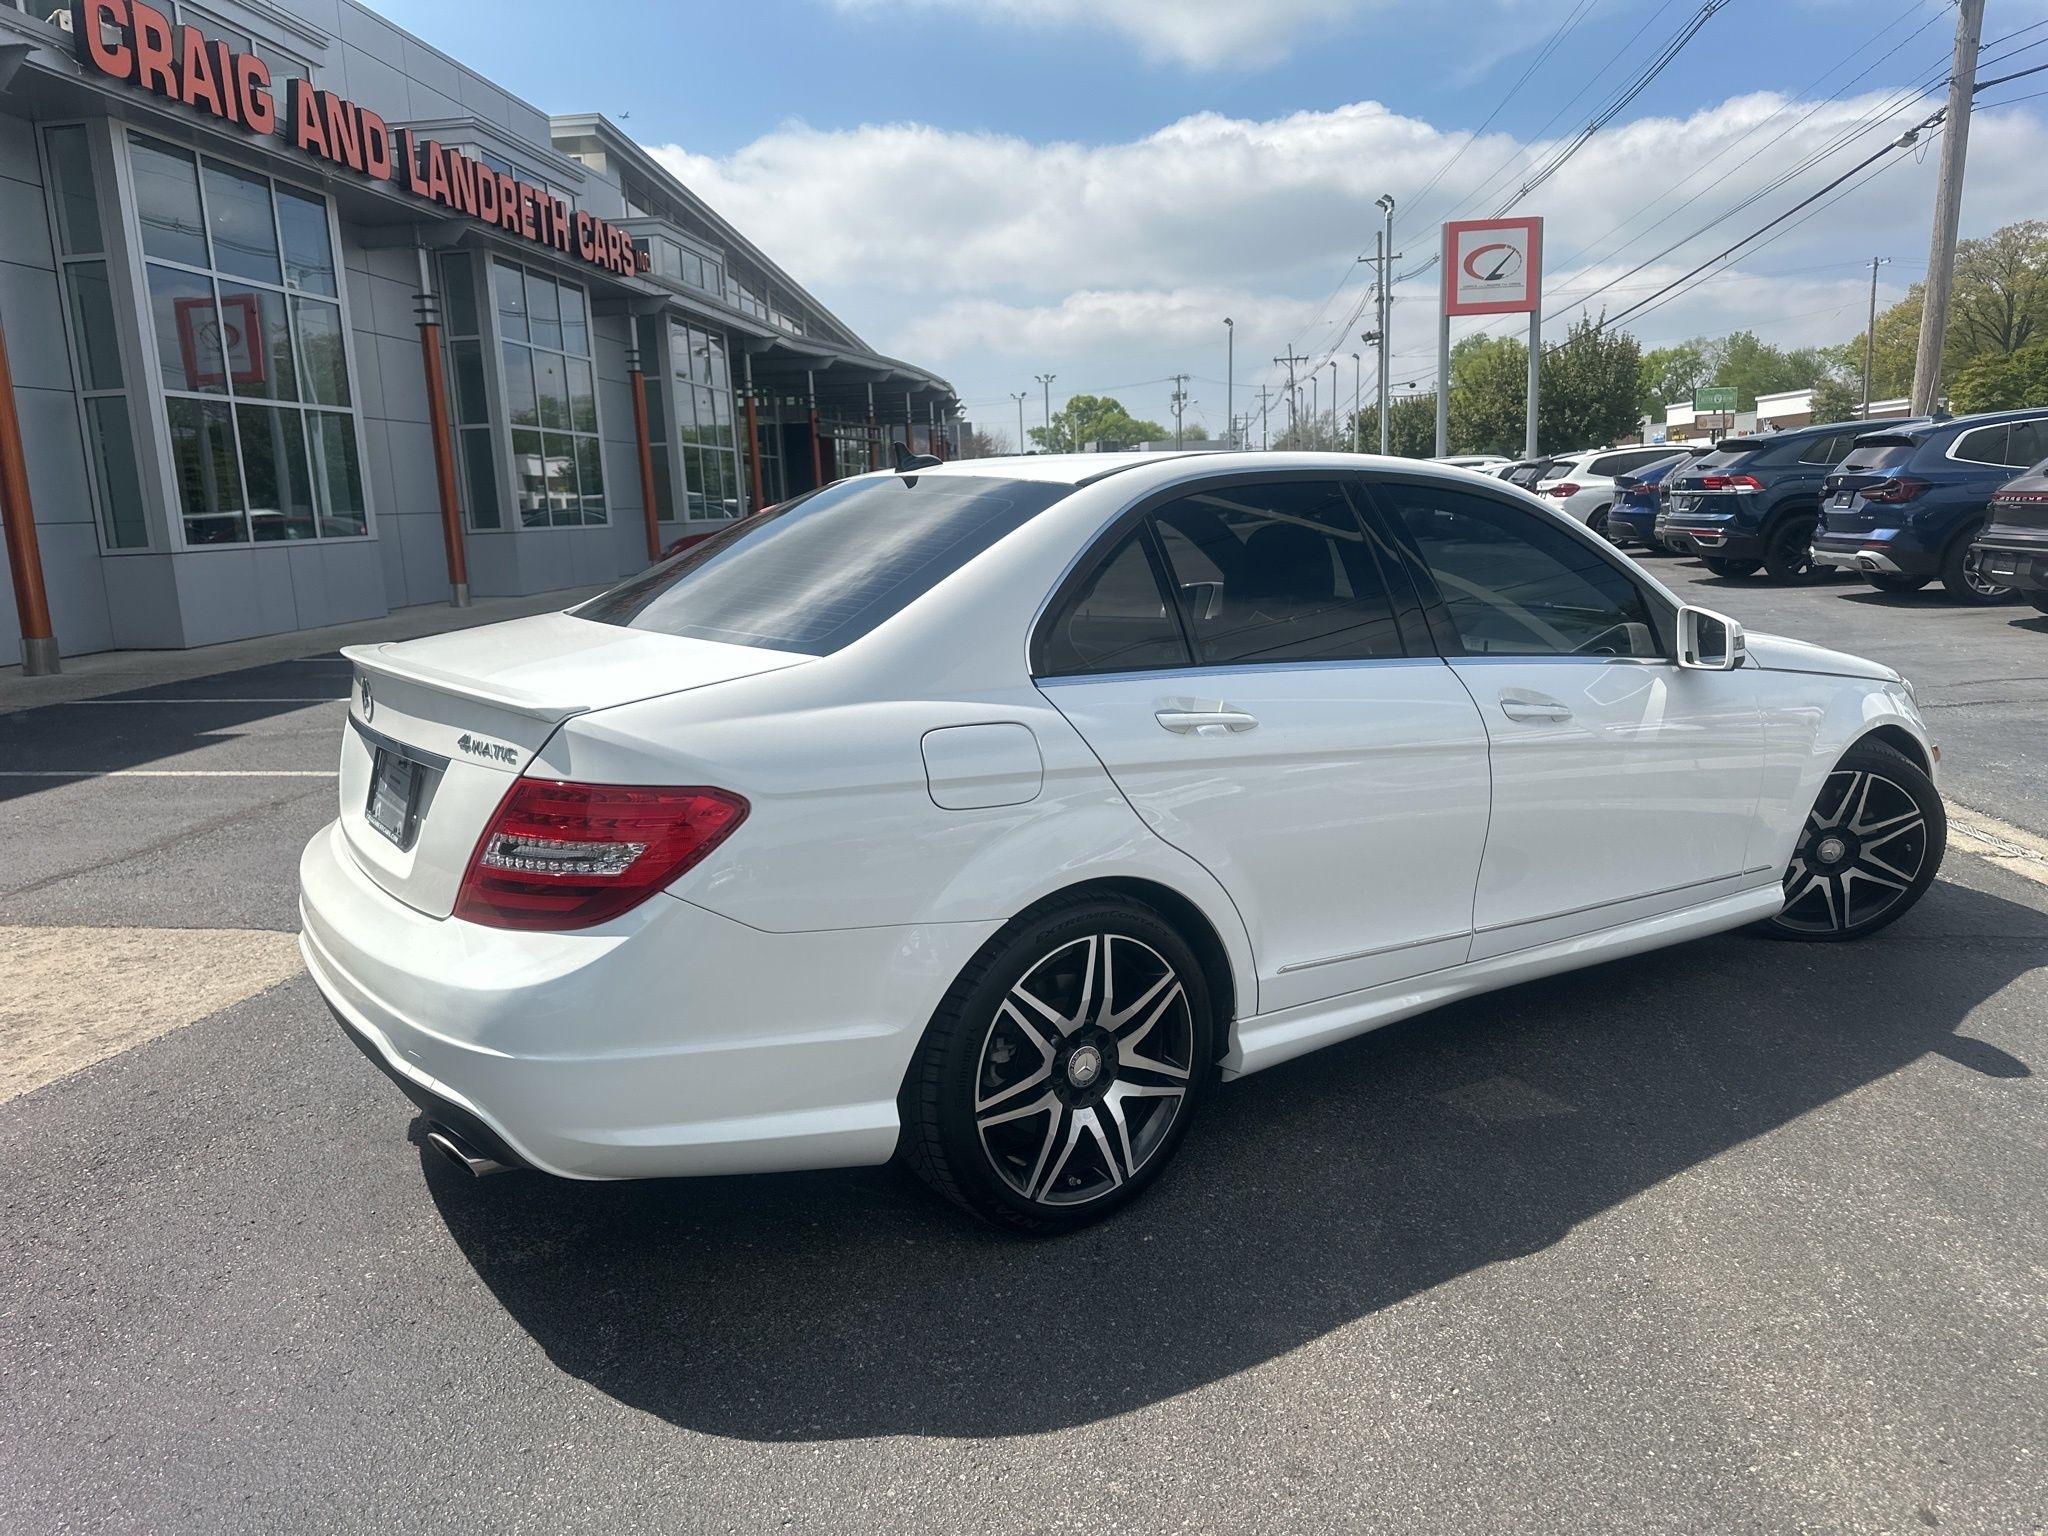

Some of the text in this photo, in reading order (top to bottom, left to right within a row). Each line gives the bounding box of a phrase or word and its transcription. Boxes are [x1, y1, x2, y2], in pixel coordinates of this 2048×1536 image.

[82, 0, 276, 135] CRAIG
[296, 77, 392, 181] AND
[402, 127, 570, 253] LANDRETH
[577, 210, 636, 278] CARS
[457, 733, 519, 766] 4MATIC
